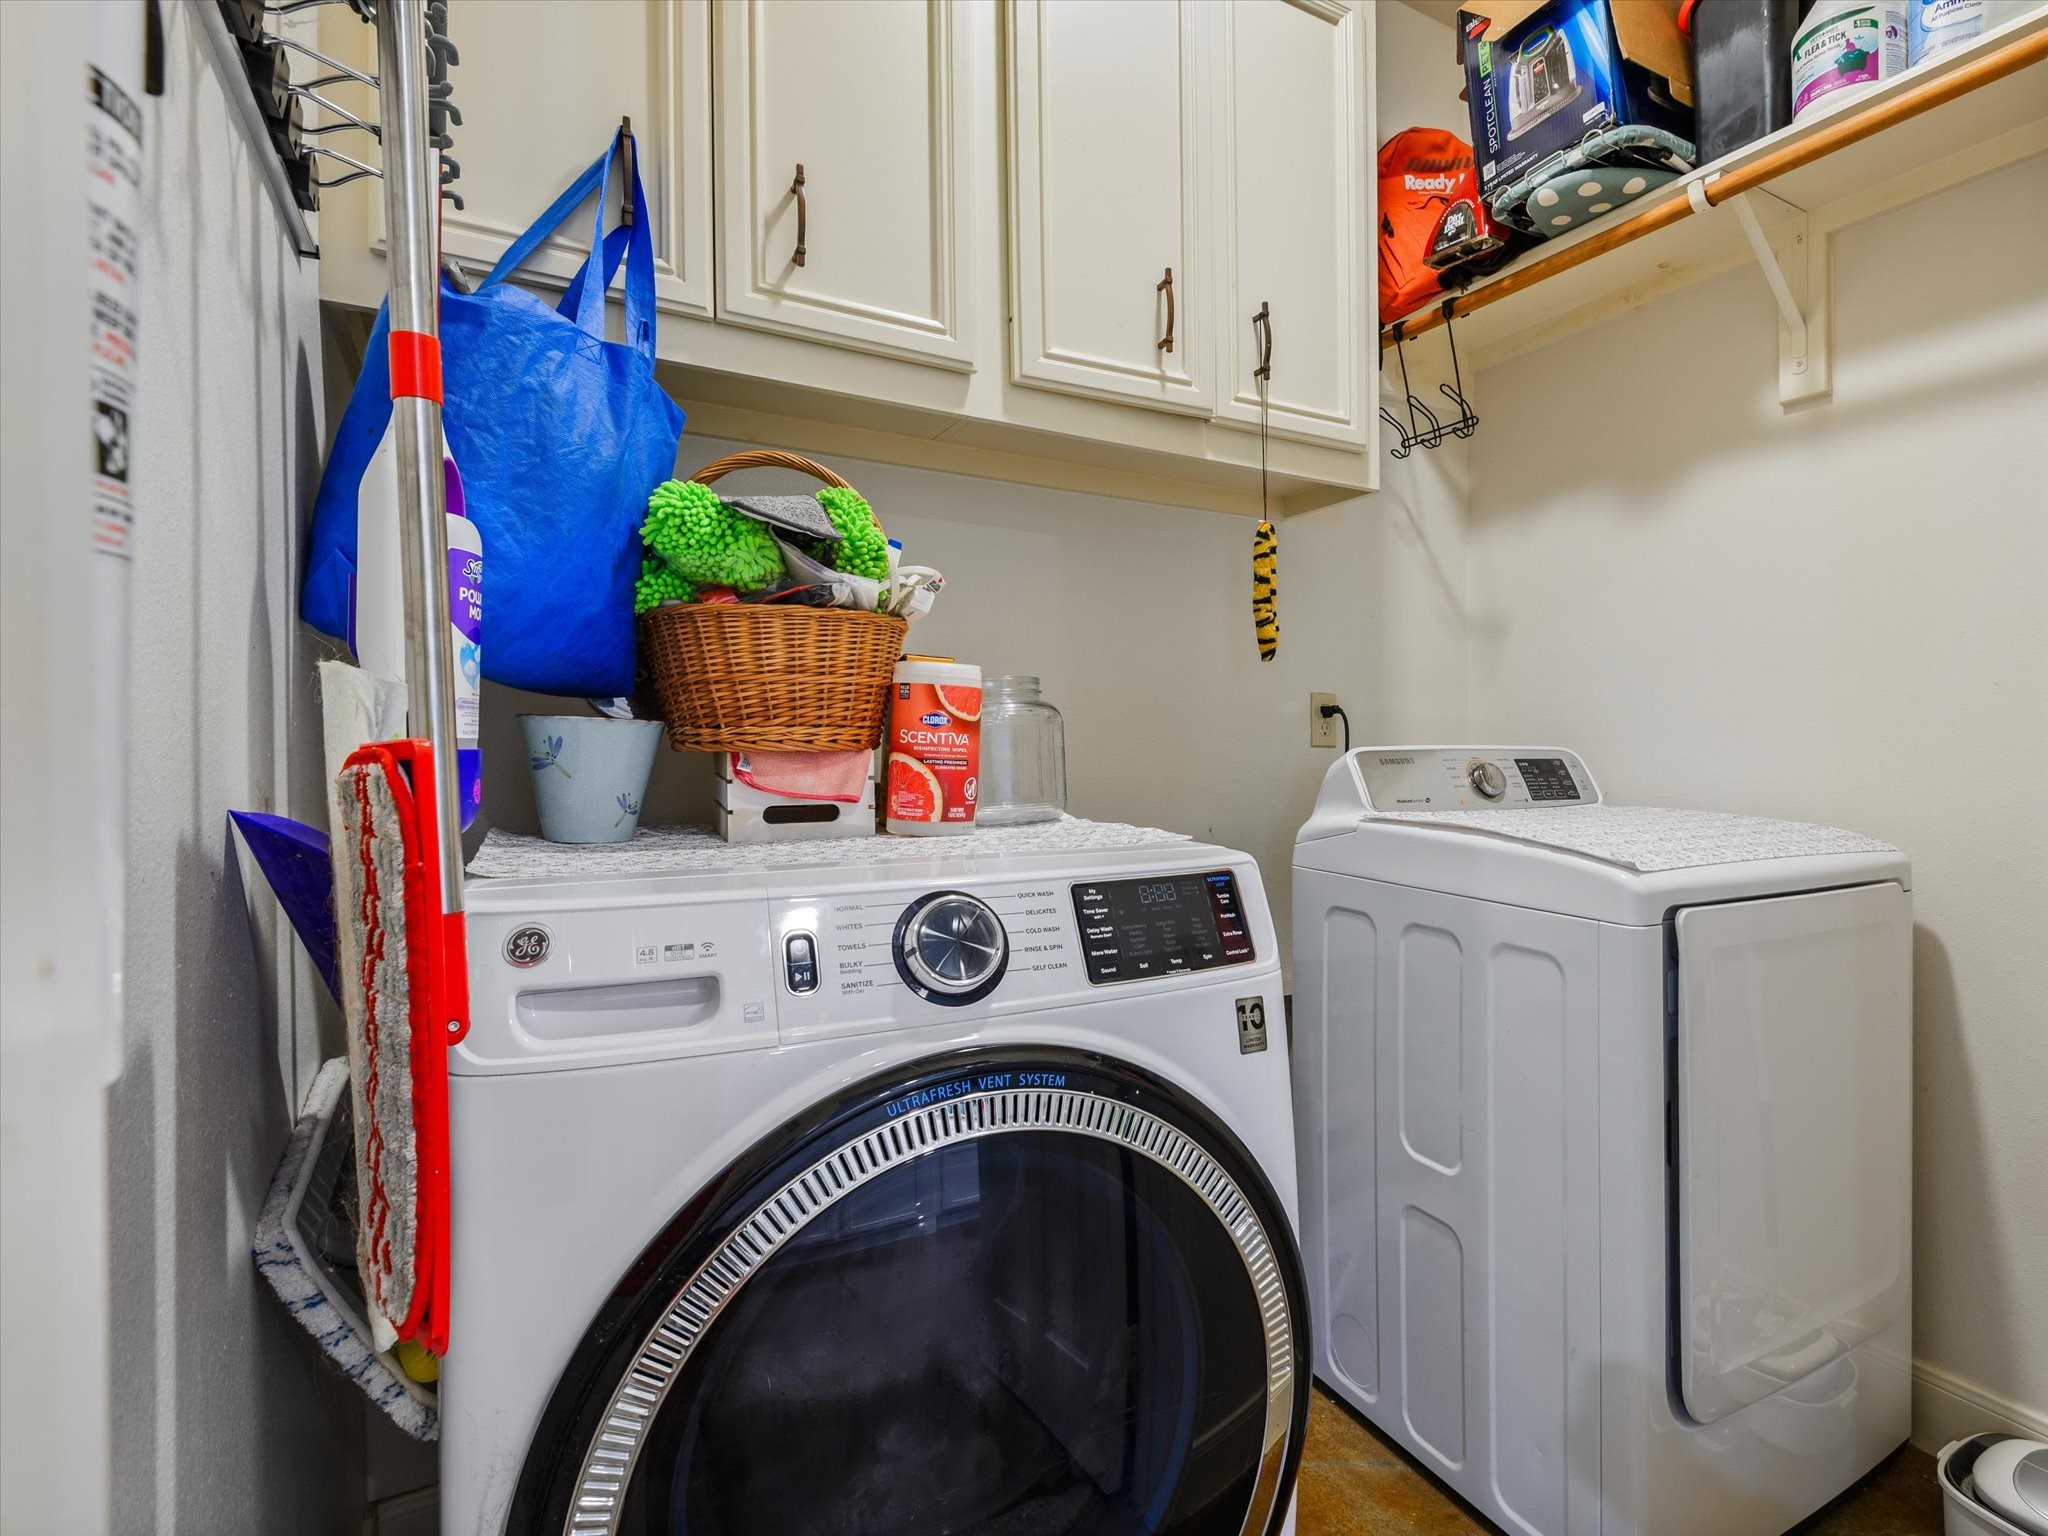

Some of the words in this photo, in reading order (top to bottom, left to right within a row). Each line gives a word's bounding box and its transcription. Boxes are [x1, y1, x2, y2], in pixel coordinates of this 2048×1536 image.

[1804, 43, 1820, 59] FLEA
[1821, 40, 1827, 49] &
[1829, 30, 1847, 45] TICK
[1480, 51, 1490, 74] PET
[1483, 78, 1498, 154] SPOTCLEAN
[922, 714, 949, 726] CLOROX
[899, 728, 970, 746] SCENTIVA
[913, 745, 951, 753] DISINFECTING
[1379, 757, 1416, 766] SAMSUNG
[834, 904, 865, 913] NORMAL
[1025, 907, 1057, 916] DELICATES
[836, 922, 863, 931] WHITES
[1025, 927, 1042, 935] COLD
[1042, 926, 1061, 934] WASH
[1100, 925, 1114, 933] Wash
[515, 935, 541, 956] GE
[837, 942, 867, 951] TOWELS
[639, 948, 655, 957] 4.8
[839, 960, 864, 969] BULKY
[1100, 966, 1117, 974] Sound
[841, 979, 874, 990] SANITIZE
[1237, 1002, 1265, 1032] 10
[886, 1080, 971, 1117] ULTRAFRESH
[978, 1074, 1012, 1091] VENT
[1018, 1073, 1066, 1088] SYSTEM
